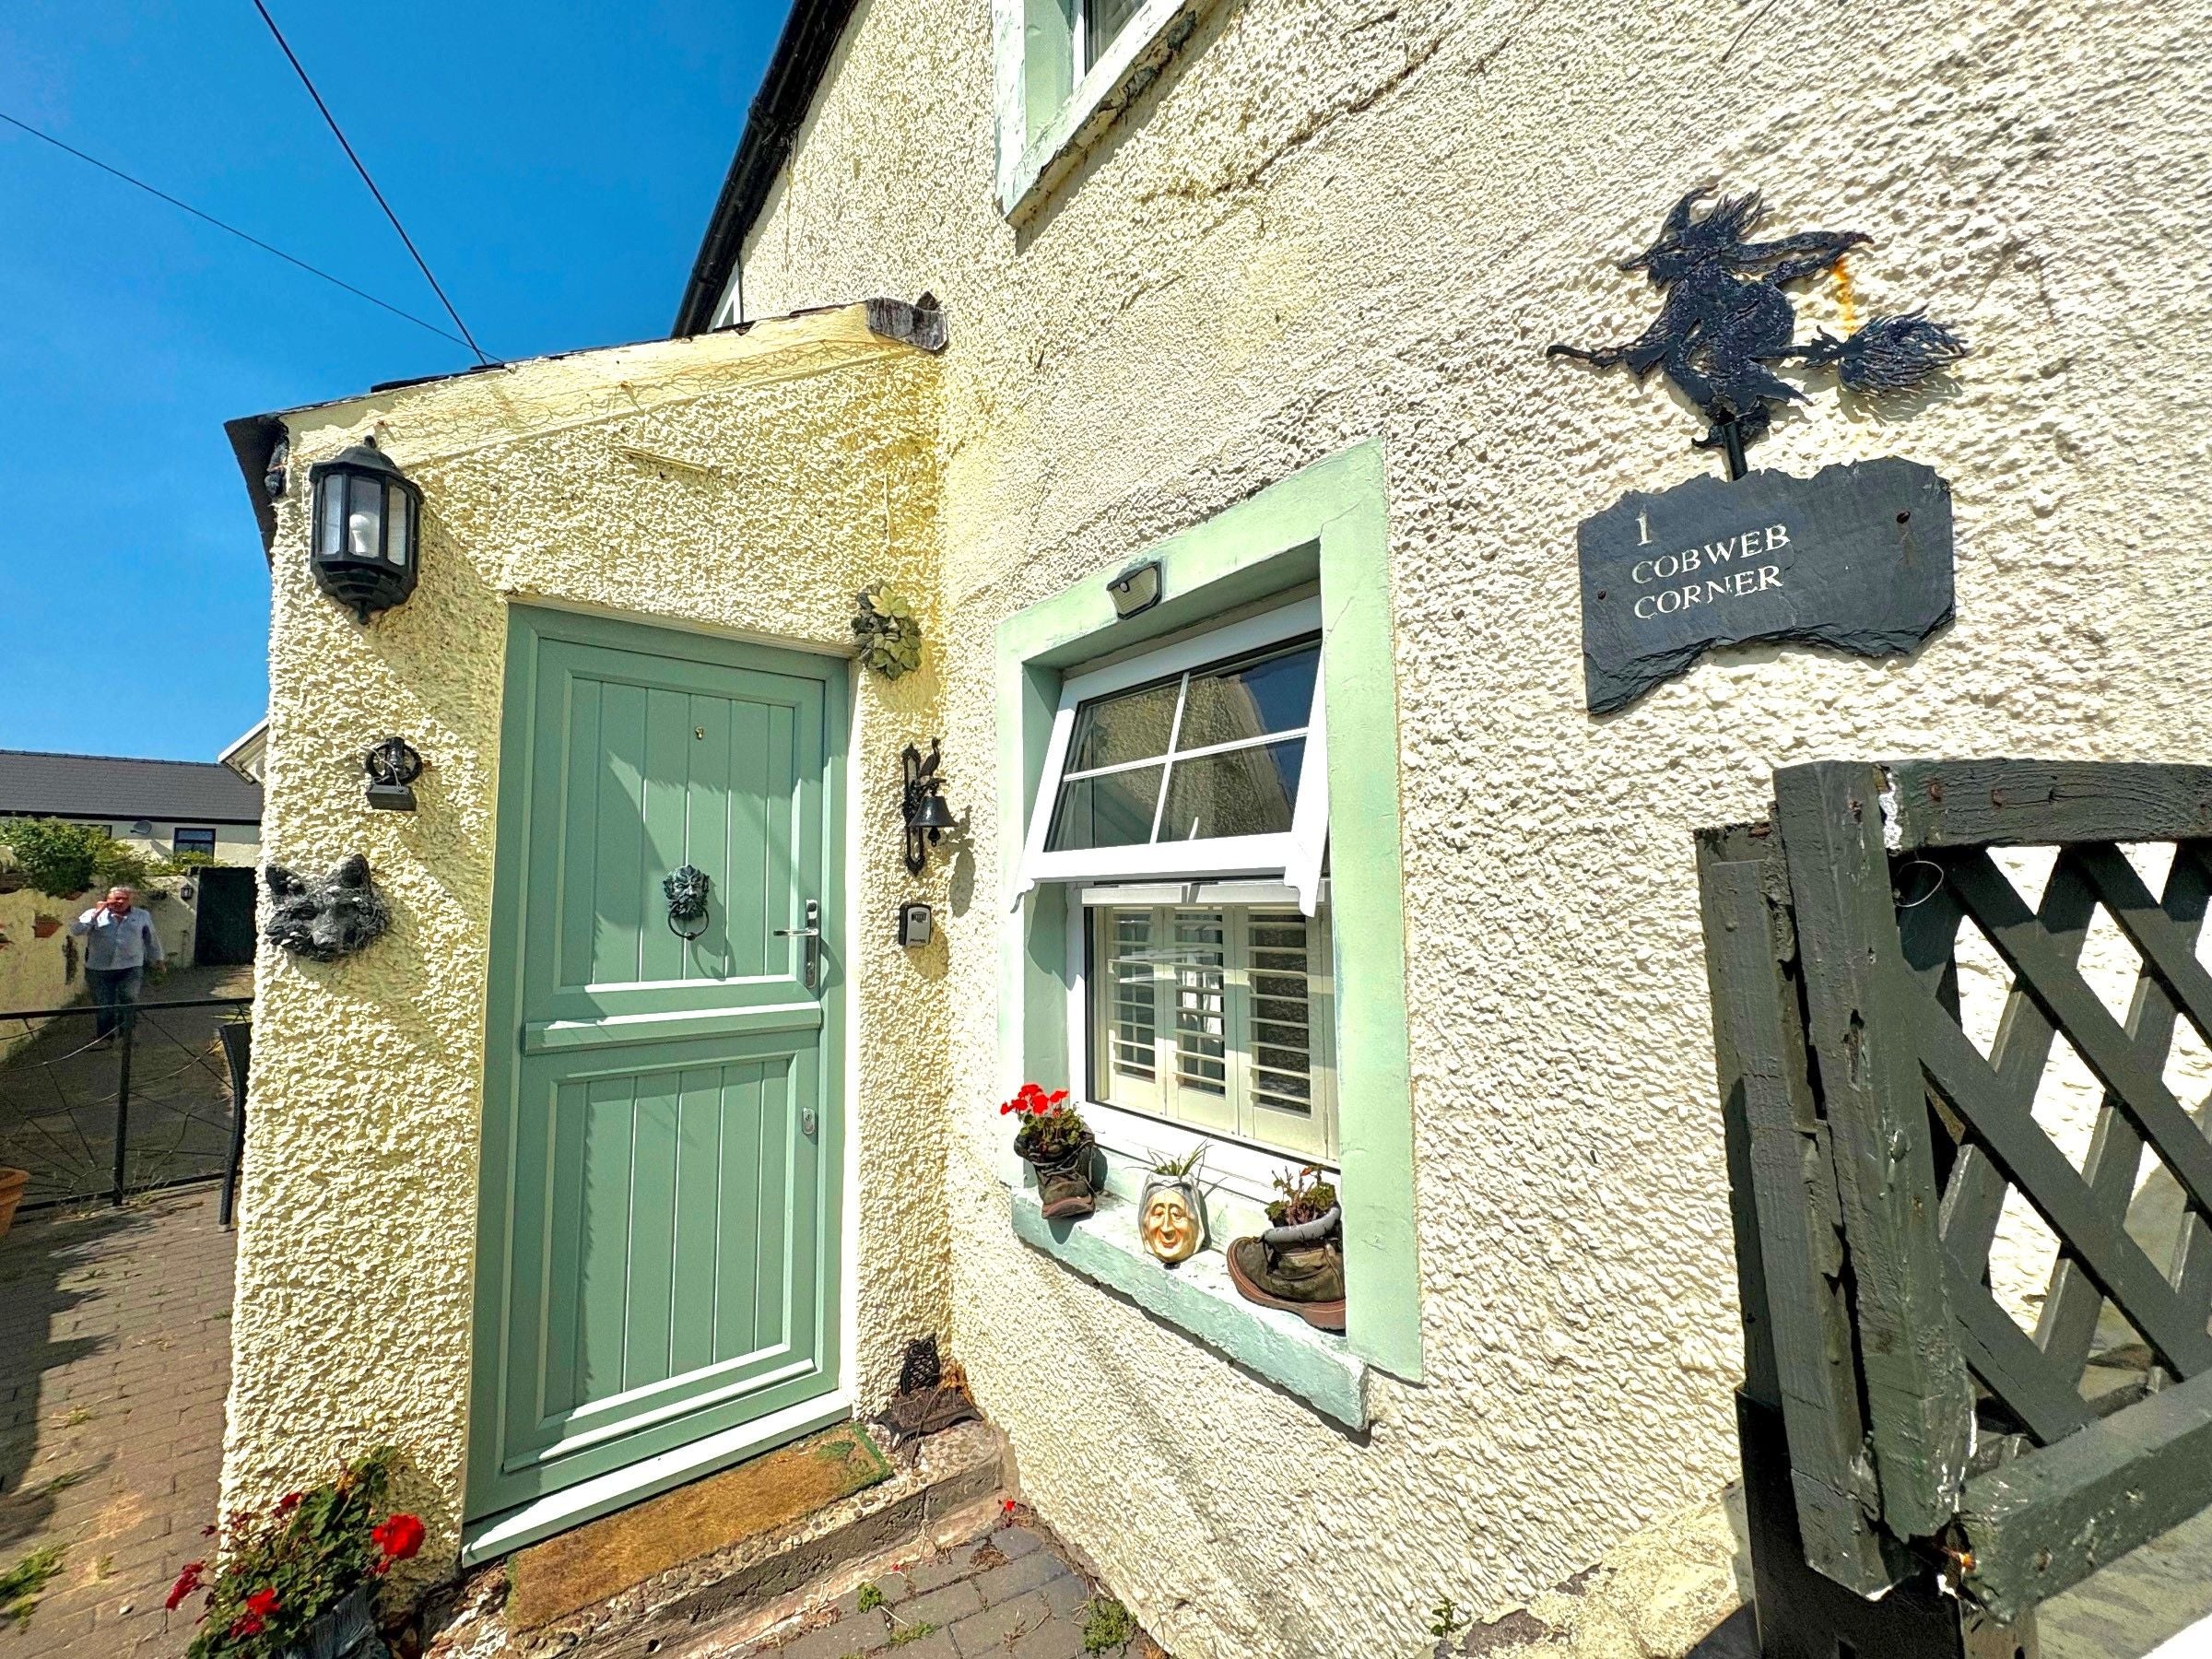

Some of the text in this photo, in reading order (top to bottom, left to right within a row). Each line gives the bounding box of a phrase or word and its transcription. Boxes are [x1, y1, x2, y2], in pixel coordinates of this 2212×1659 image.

[1631, 524, 1791, 584] COBWEB
[1635, 510, 1653, 547] 1
[1634, 565, 1784, 620] CORNER
